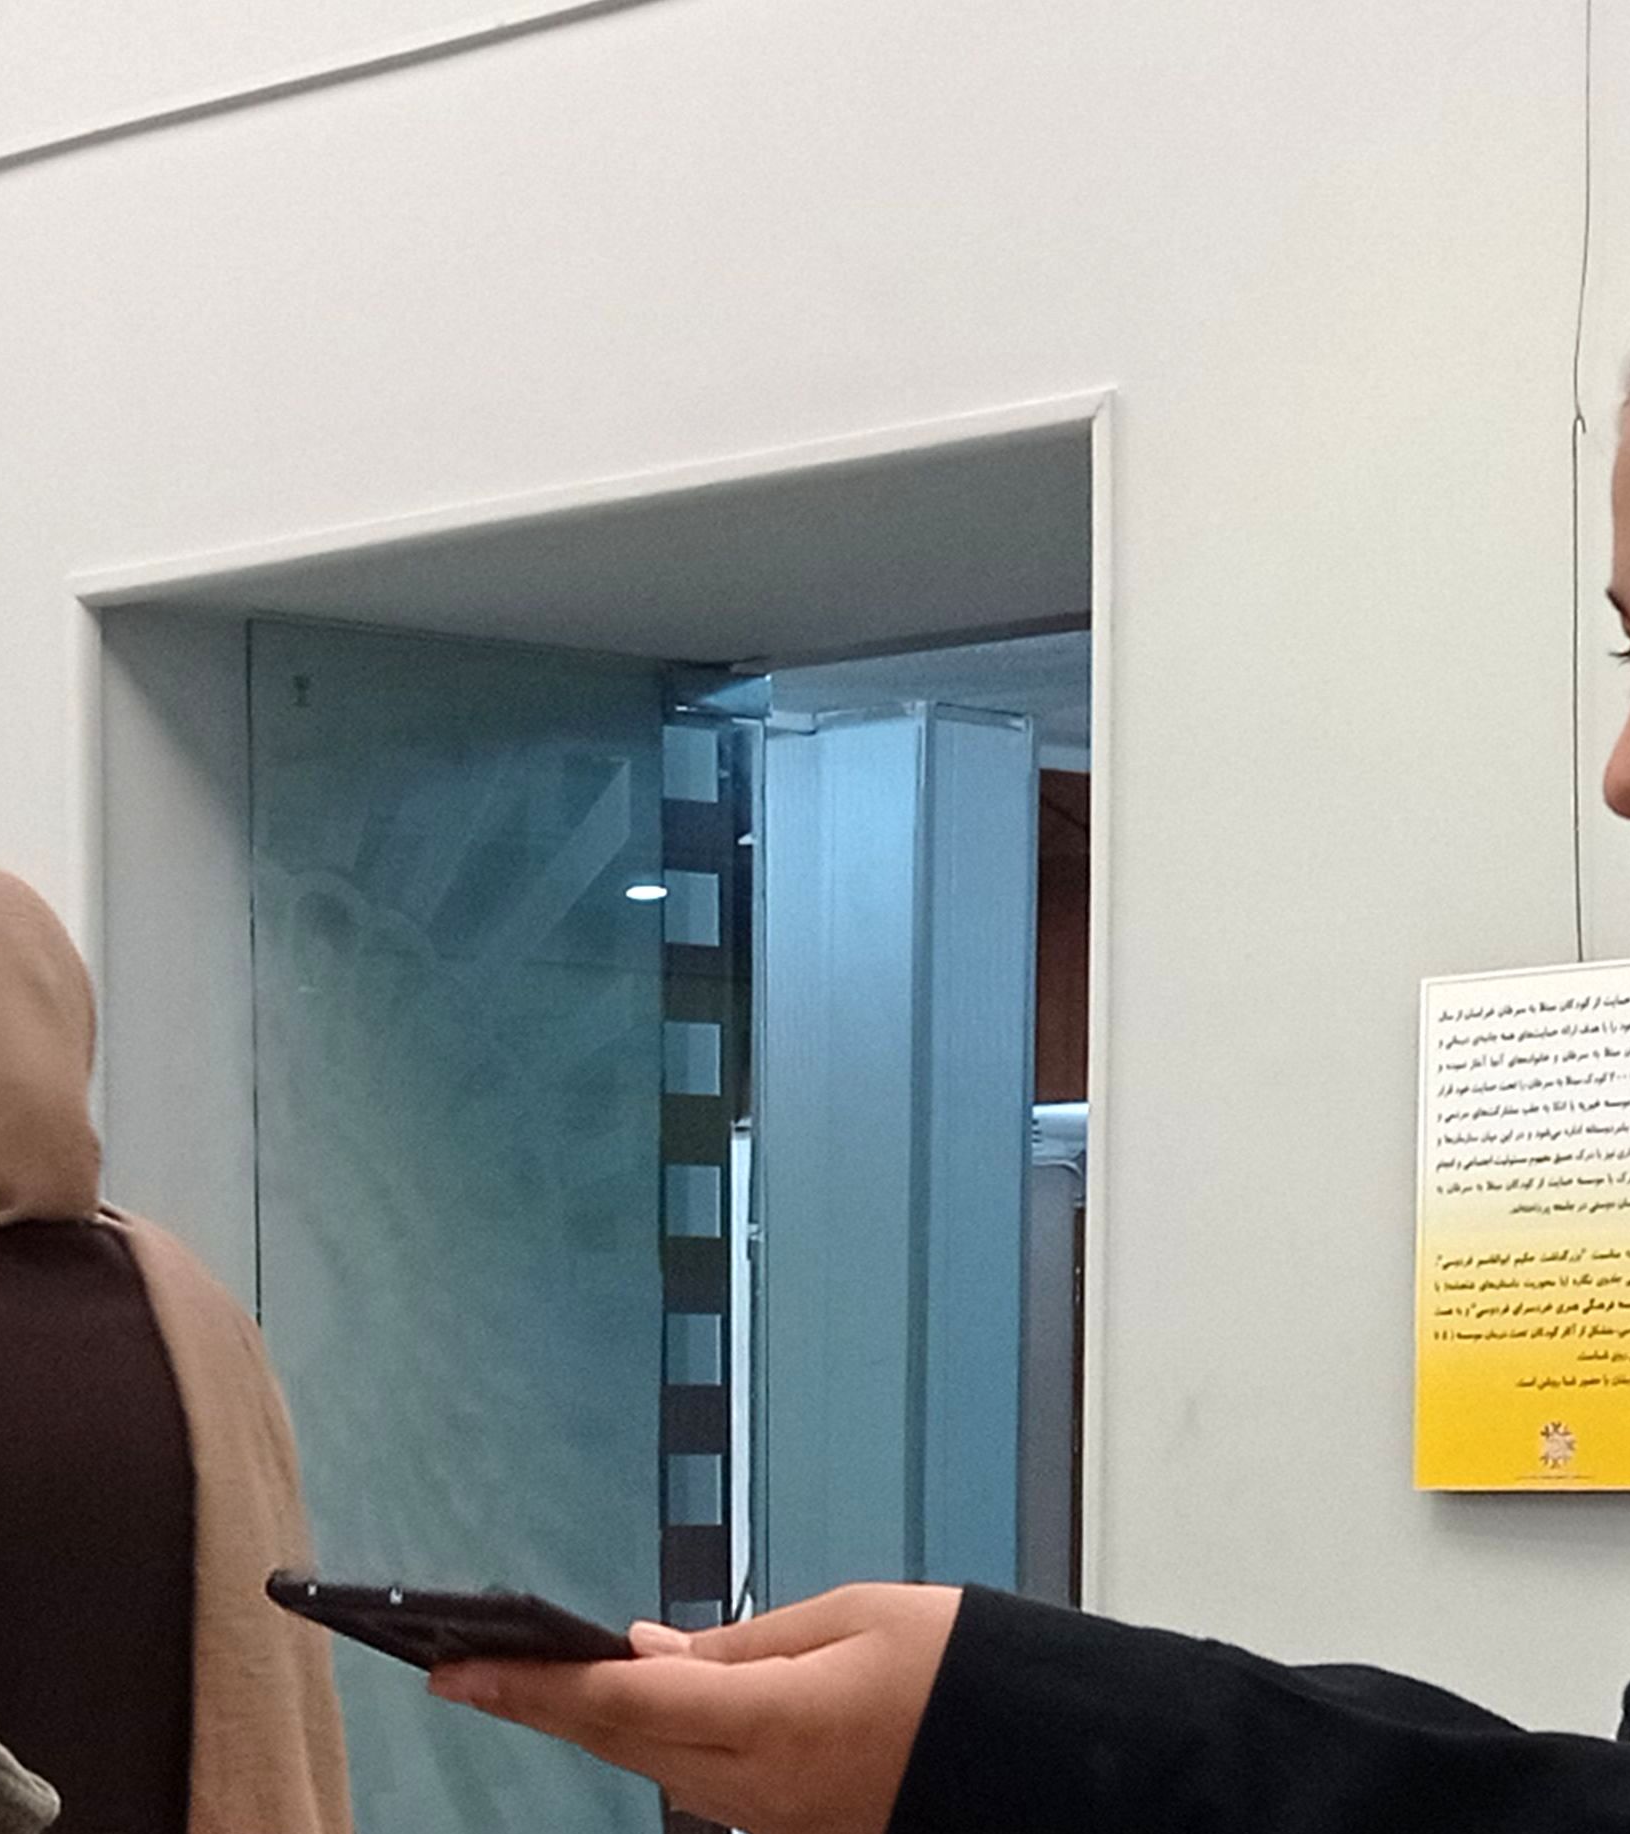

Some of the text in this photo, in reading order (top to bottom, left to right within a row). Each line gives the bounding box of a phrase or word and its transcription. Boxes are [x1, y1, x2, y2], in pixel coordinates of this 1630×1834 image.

[1539, 1002, 1557, 1012] مبتلا
[1559, 996, 1590, 1012] کودکان
[1603, 996, 1630, 1008] حمایت
[1437, 1011, 1453, 1023] سال
[1497, 1006, 1526, 1018] سرطان
[1579, 1025, 1599, 1034] هدف
[1500, 1033, 1515, 1041] همه
[1561, 1050, 1589, 1063] سرطان
[1604, 1047, 1621, 1057] مبتلا
[1565, 1076, 1582, 1085] مبتلا
[1583, 1072, 1607, 1085] کودک
[1471, 1082, 1497, 1093] حمایت
[1527, 1079, 1554, 1090] سرطان
[1455, 1086, 1470, 1096] خود
[1577, 1100, 1600, 1112] خیریه
[1499, 1129, 1513, 1144] این
[1575, 1148, 1595, 1162] درک
[1486, 1181, 1503, 1191] مبتلا
[1505, 1178, 1534, 1191] کودکان
[1547, 1177, 1573, 1188] حمایت
[1446, 1183, 1473, 1194] سرطان
[1530, 1326, 1559, 1339] کودکان
